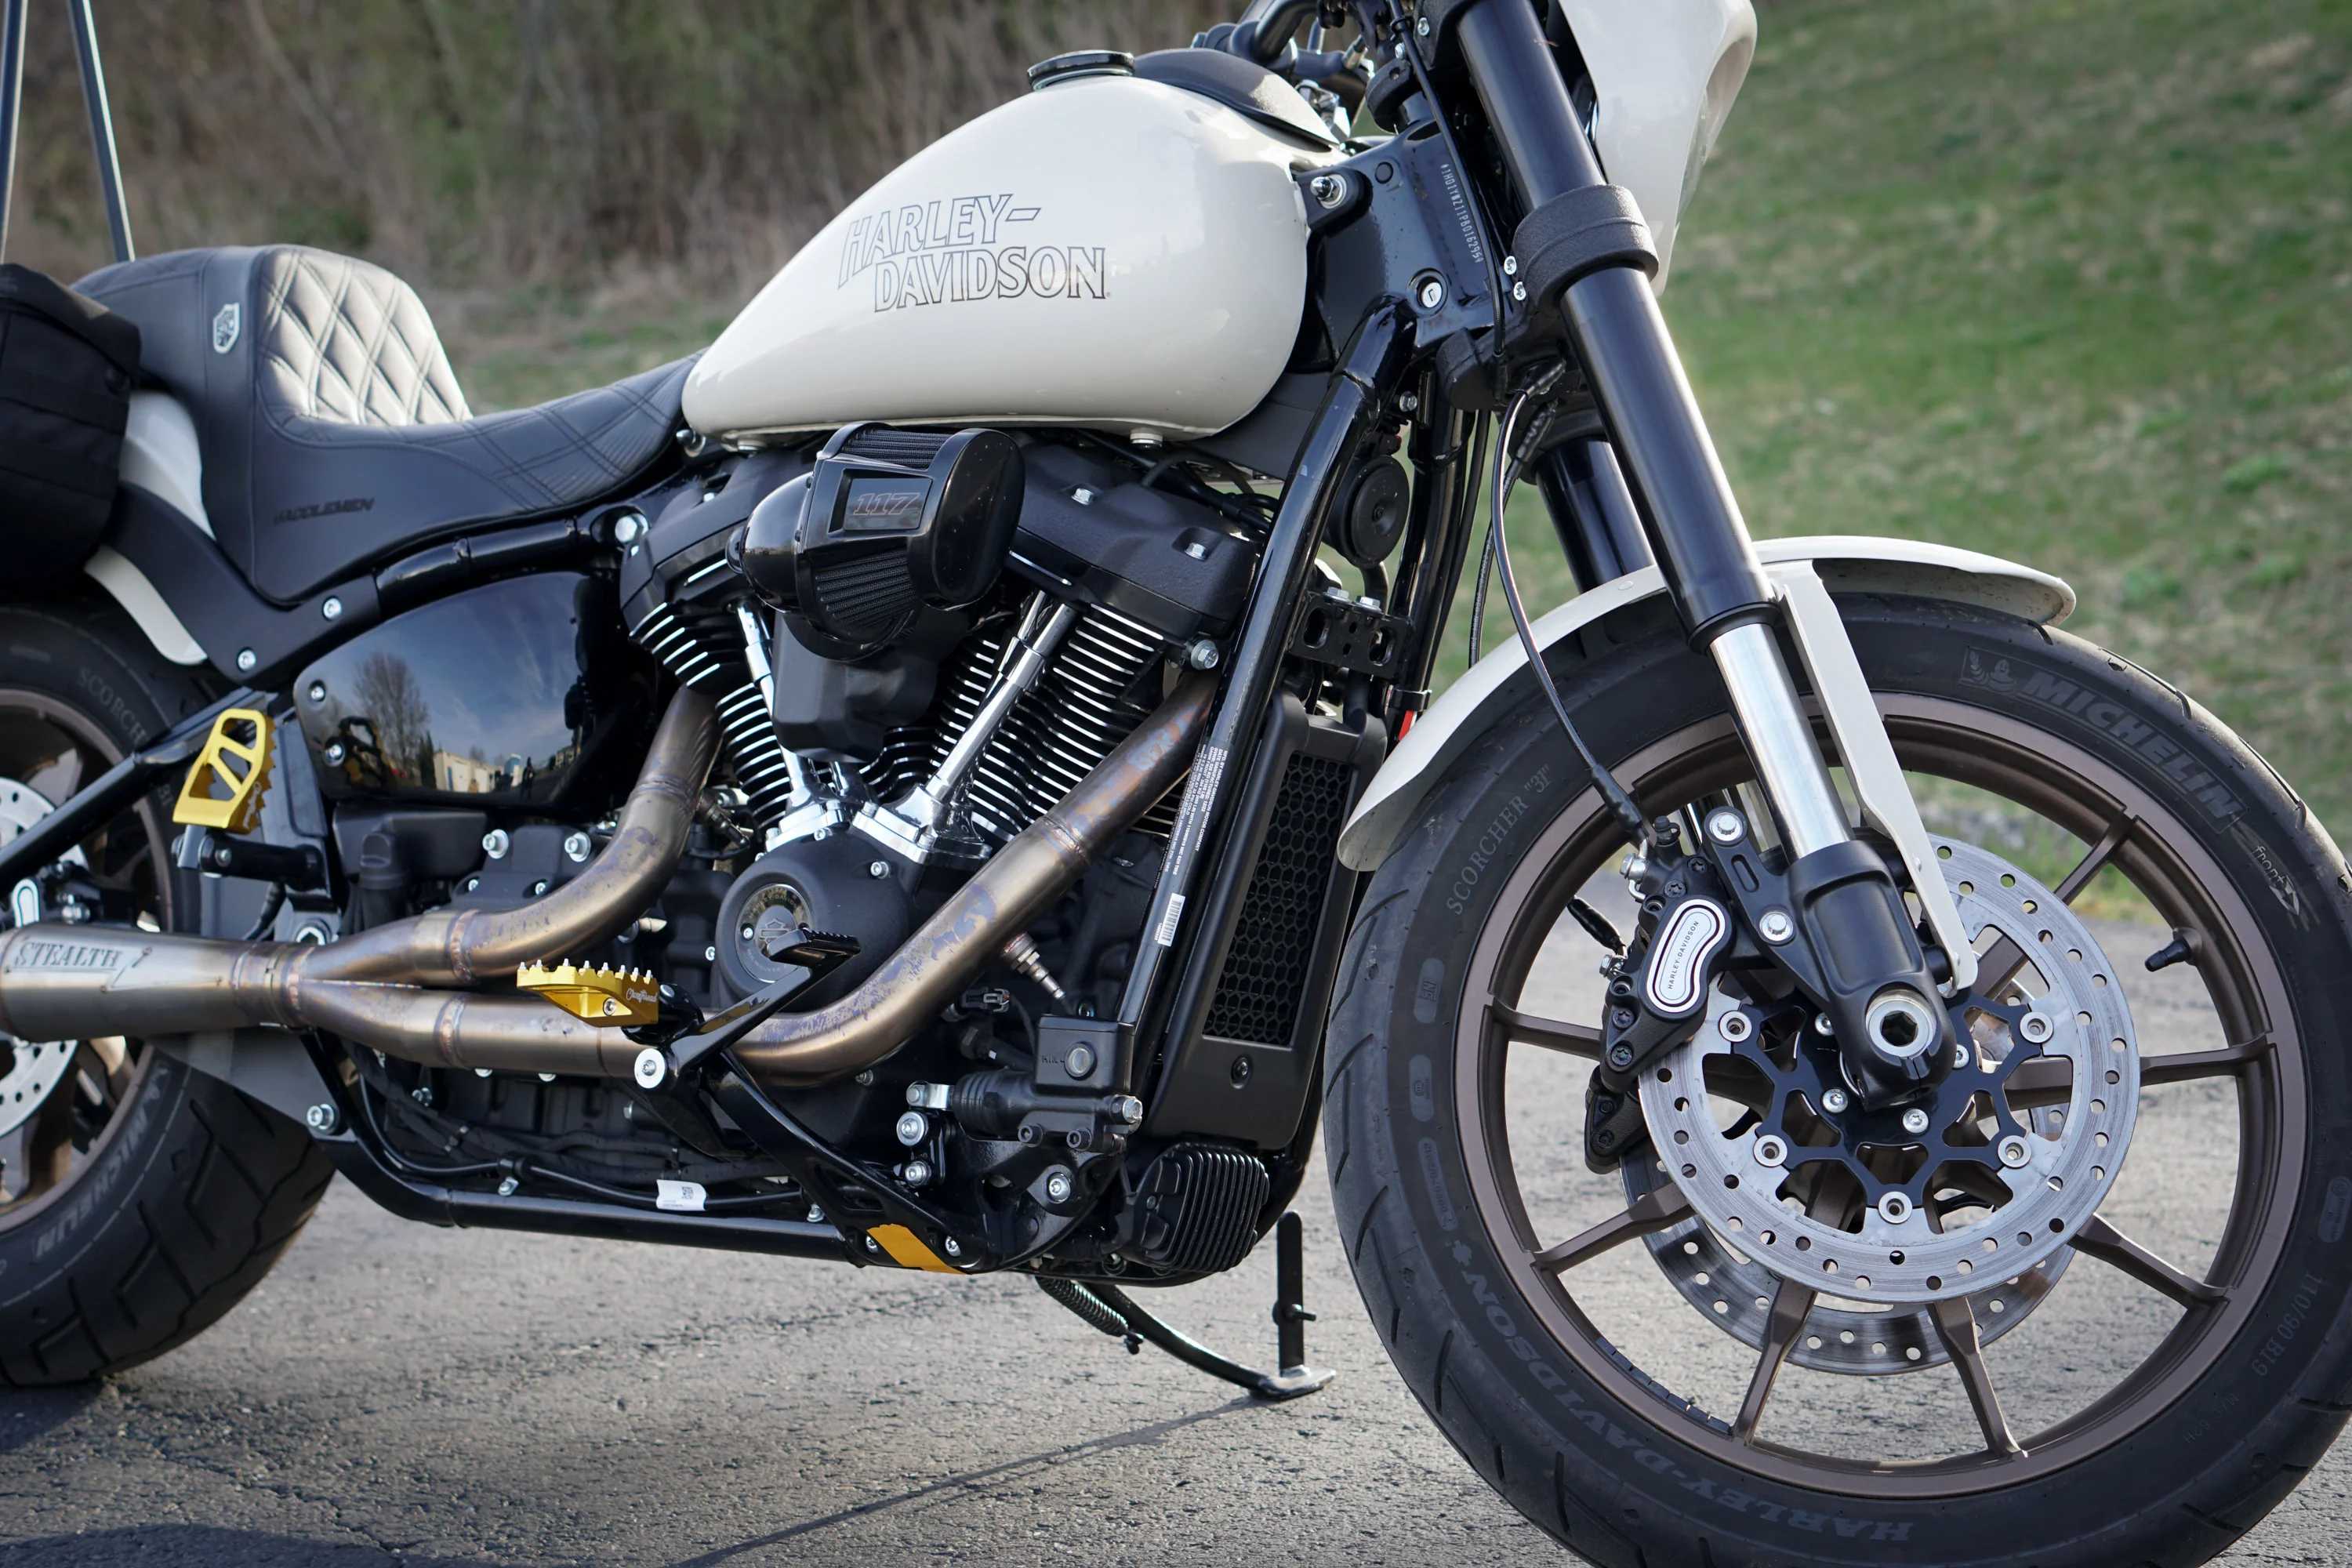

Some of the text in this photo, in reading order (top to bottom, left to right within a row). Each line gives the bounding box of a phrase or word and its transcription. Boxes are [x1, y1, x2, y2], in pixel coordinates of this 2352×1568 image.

[838, 194, 1041, 289] HARLEY-
[874, 245, 1107, 313] DAVIDSON
[852, 492, 921, 516] 117
[77, 666, 151, 750] SCORCH
[2022, 671, 2244, 819] MICHELIN
[1200, 811, 1210, 829] MOTOR
[1206, 768, 1223, 811] HARLEY-DAVIDSON
[1193, 827, 1205, 851] COMPANY
[1446, 795, 1529, 915] SCORCHER
[2249, 840, 2288, 890] front
[14, 941, 124, 967] STEALTH
[1667, 920, 1700, 990] HARLEY-DAVIDSON
[1464, 1270, 1915, 1542] HARLEY-DAVIDSON
